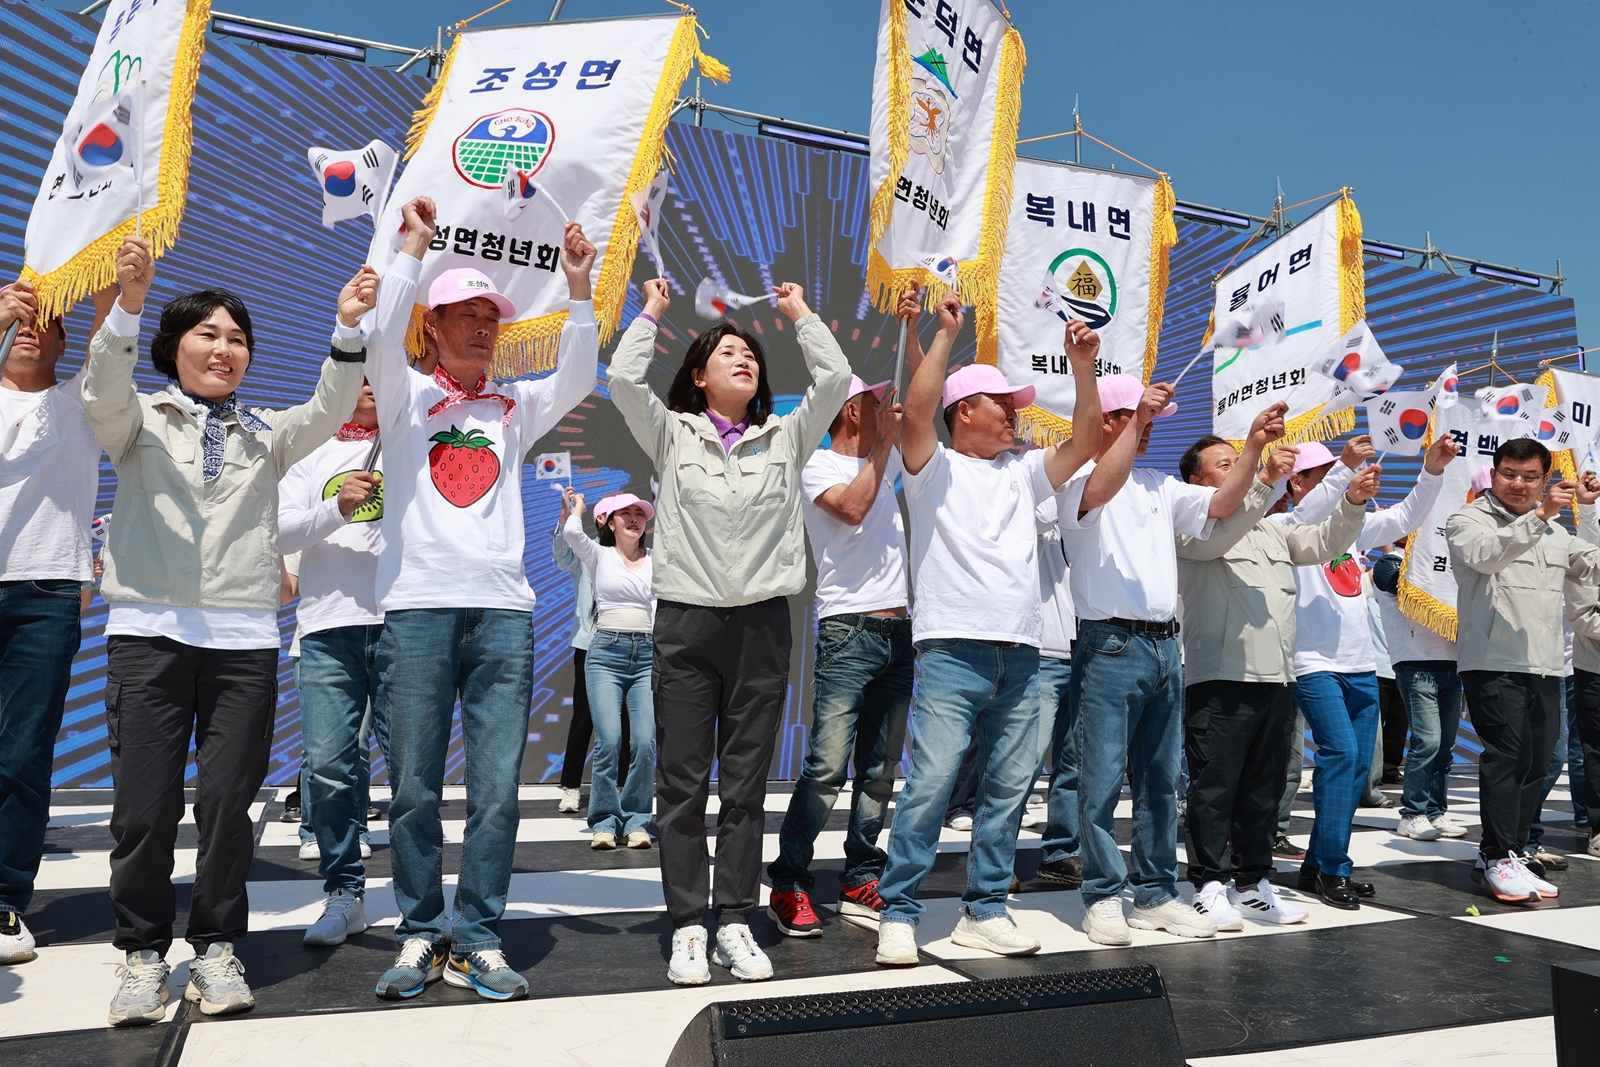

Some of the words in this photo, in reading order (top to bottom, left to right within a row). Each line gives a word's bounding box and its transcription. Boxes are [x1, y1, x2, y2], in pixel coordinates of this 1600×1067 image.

[469, 59, 621, 93] 조성면
[494, 116, 513, 126] CHO
[515, 116, 535, 129] SUNG
[1026, 192, 1130, 240] 복내면
[428, 225, 561, 273] 성면청년회
[1071, 271, 1097, 298] 福
[1229, 243, 1312, 312] 율어면
[1217, 367, 1305, 416] 율어면청년회
